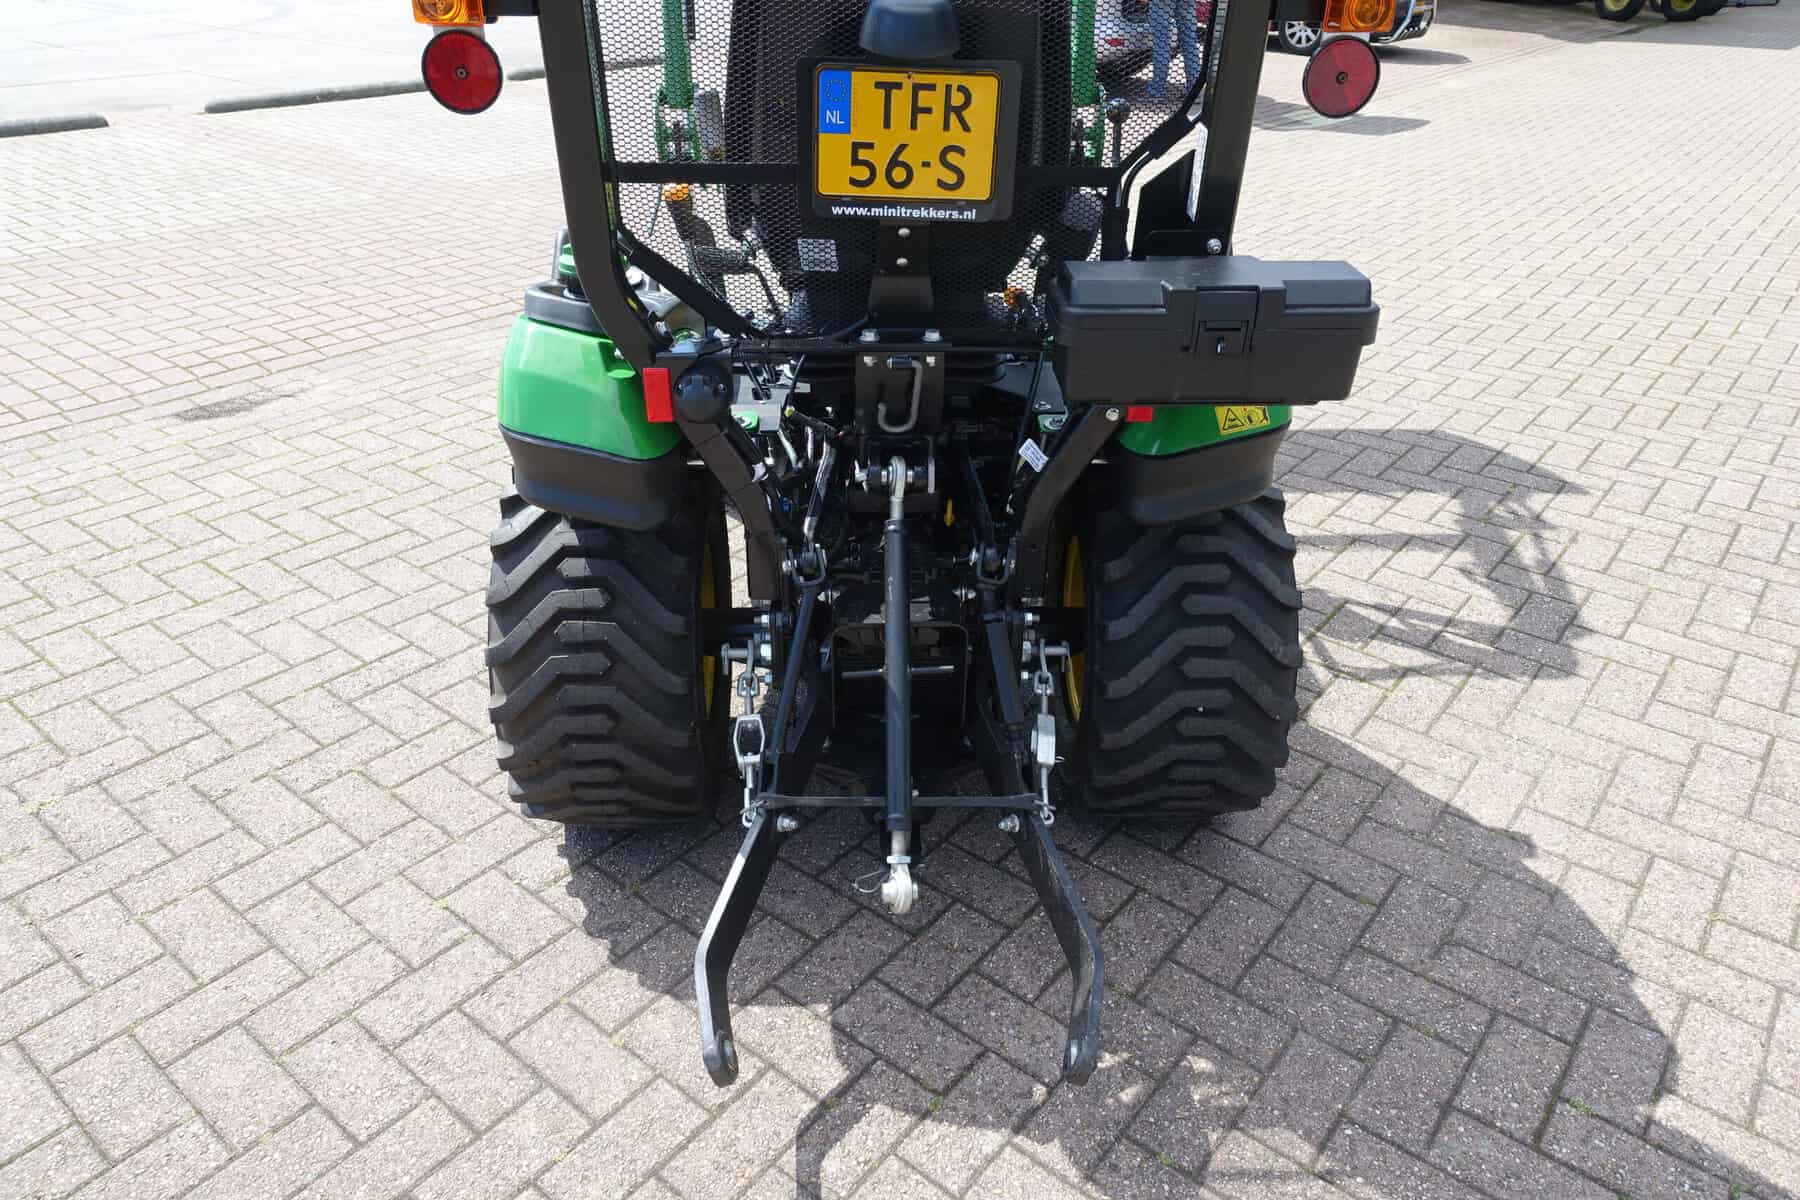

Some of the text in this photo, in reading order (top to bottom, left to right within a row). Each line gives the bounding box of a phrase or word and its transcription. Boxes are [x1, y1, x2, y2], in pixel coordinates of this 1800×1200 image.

[825, 109, 845, 125] NL
[874, 81, 972, 133] TFR
[848, 141, 966, 191] 56-S
[831, 205, 977, 220] www.minitrekkers.nl
